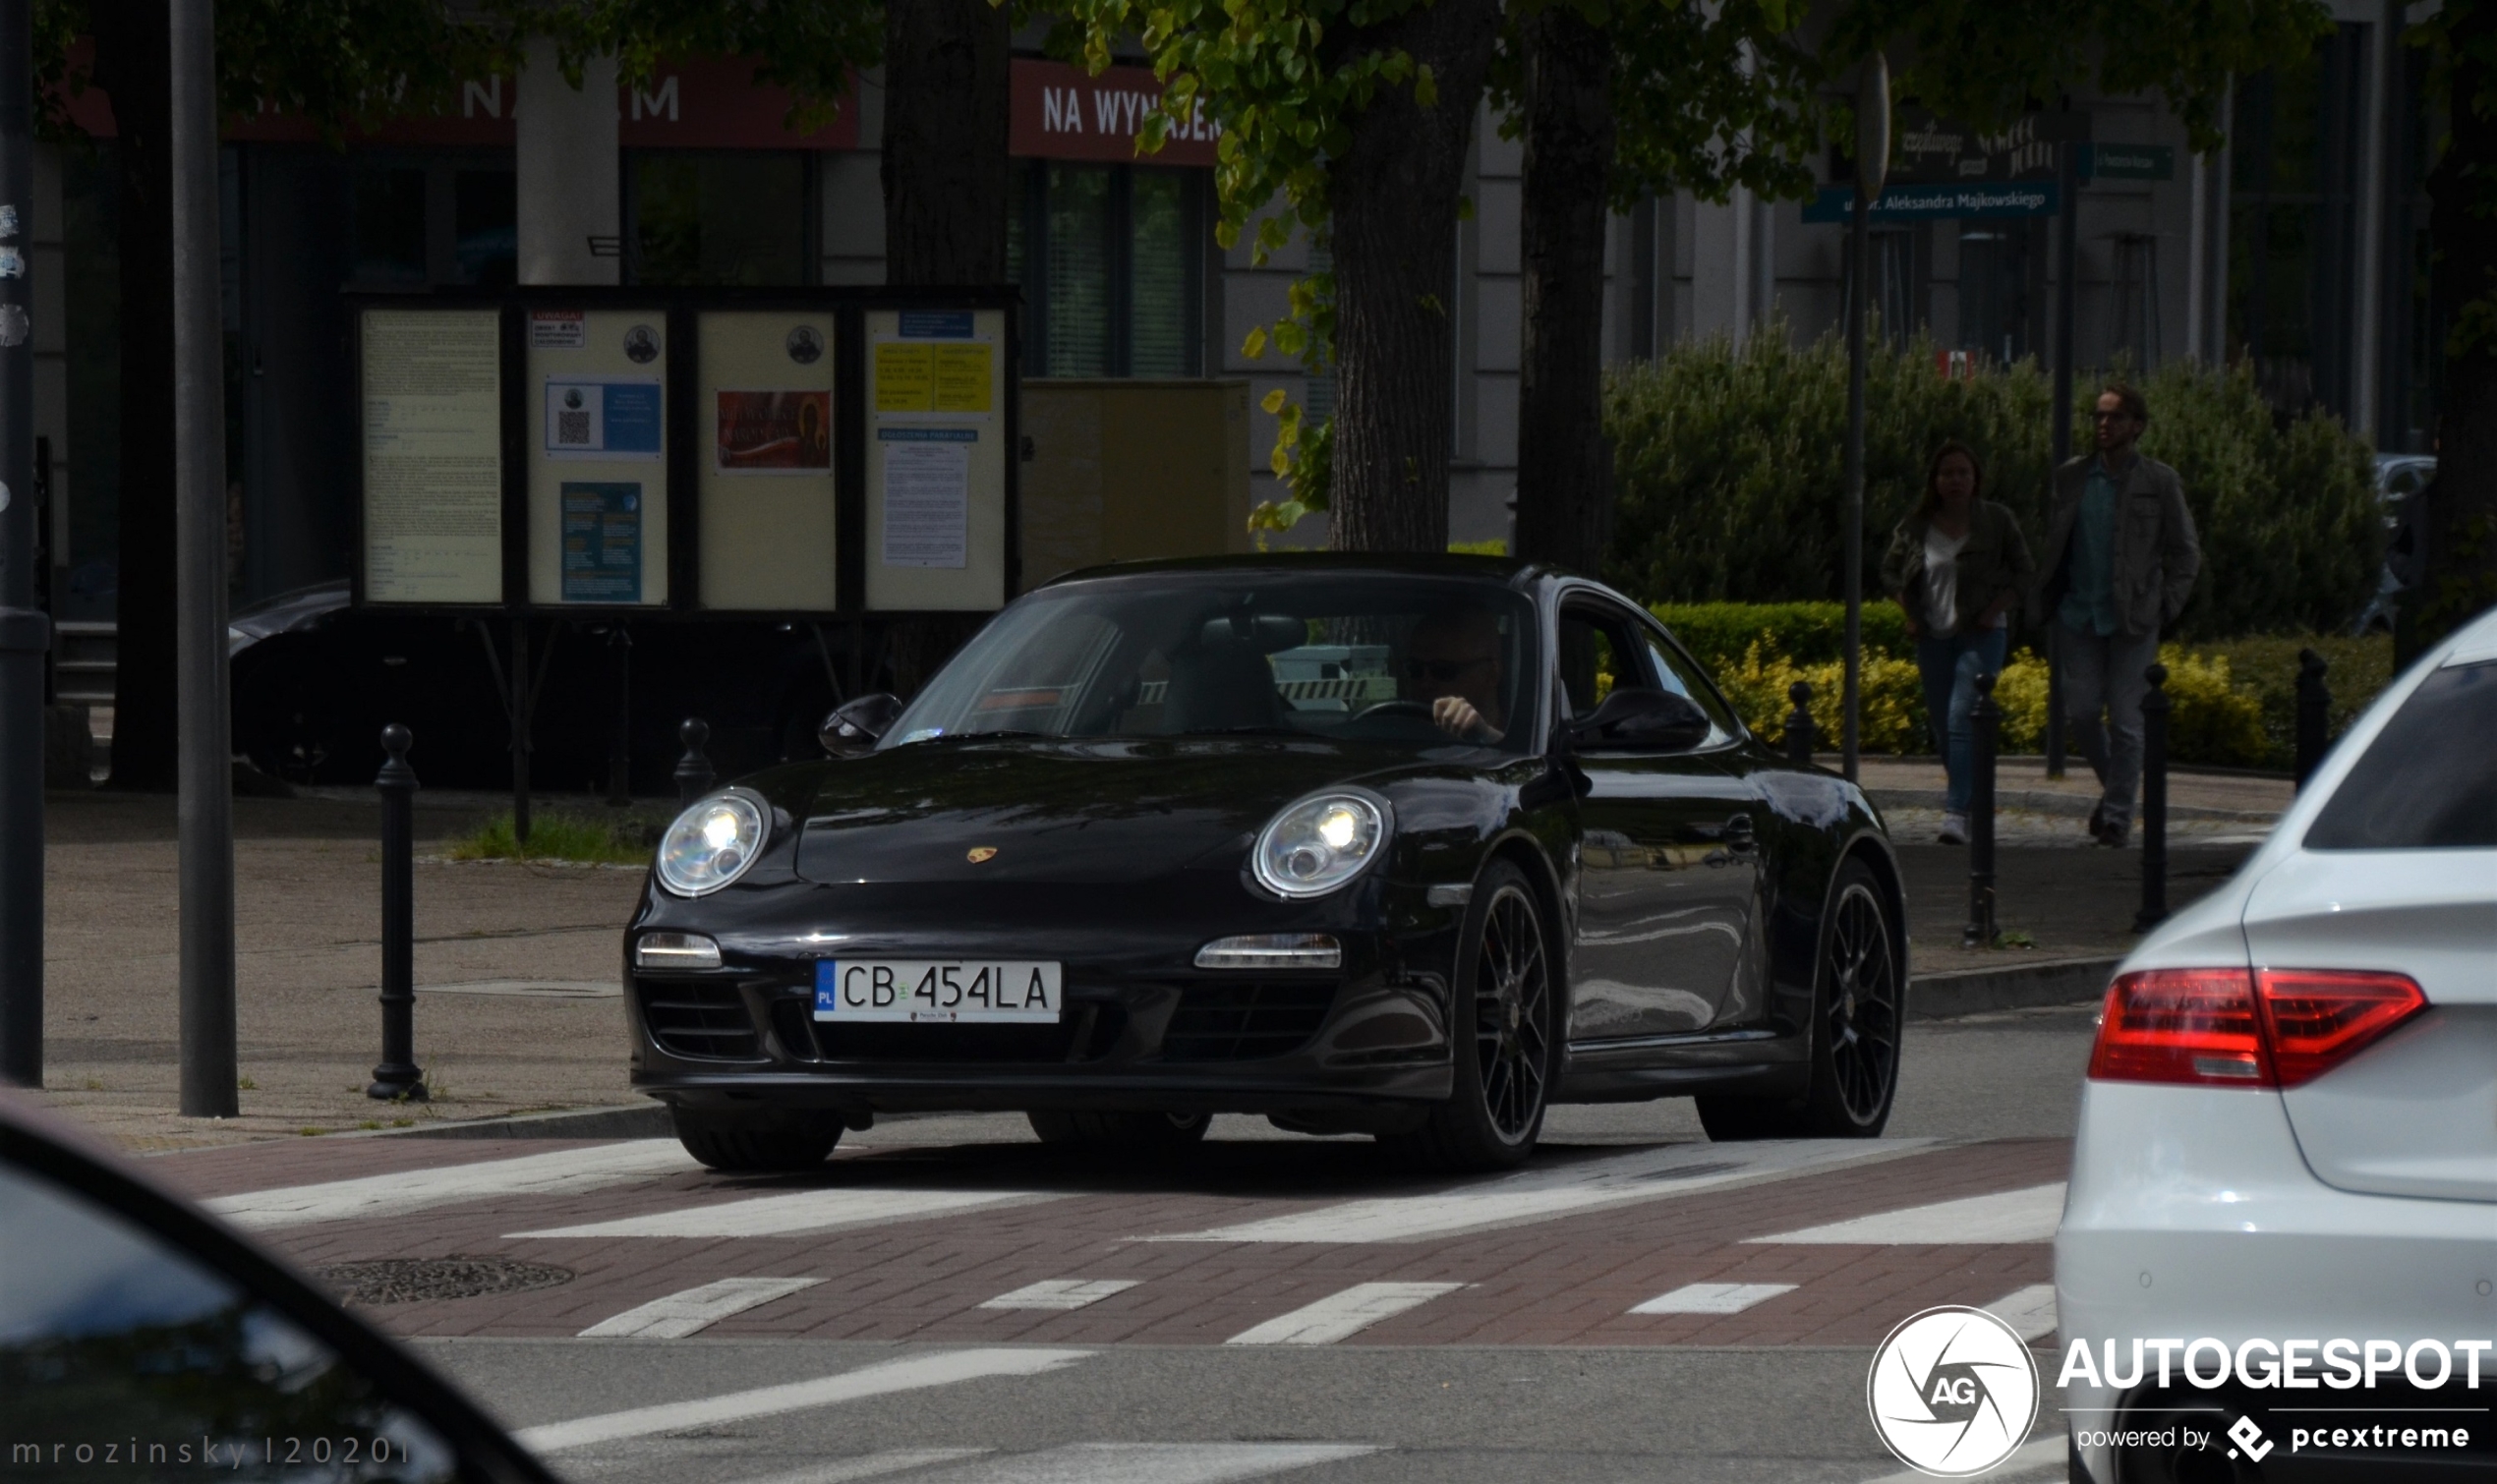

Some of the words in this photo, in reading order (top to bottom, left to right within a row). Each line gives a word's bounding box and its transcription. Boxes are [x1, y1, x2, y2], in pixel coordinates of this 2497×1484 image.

[1044, 86, 1082, 134] NA
[1886, 194, 1954, 211] Aleksandra
[1958, 191, 2046, 212] Majkowskiego
[818, 993, 833, 1004] PL
[844, 966, 896, 1007] CB
[914, 966, 1049, 1009] 454LA
